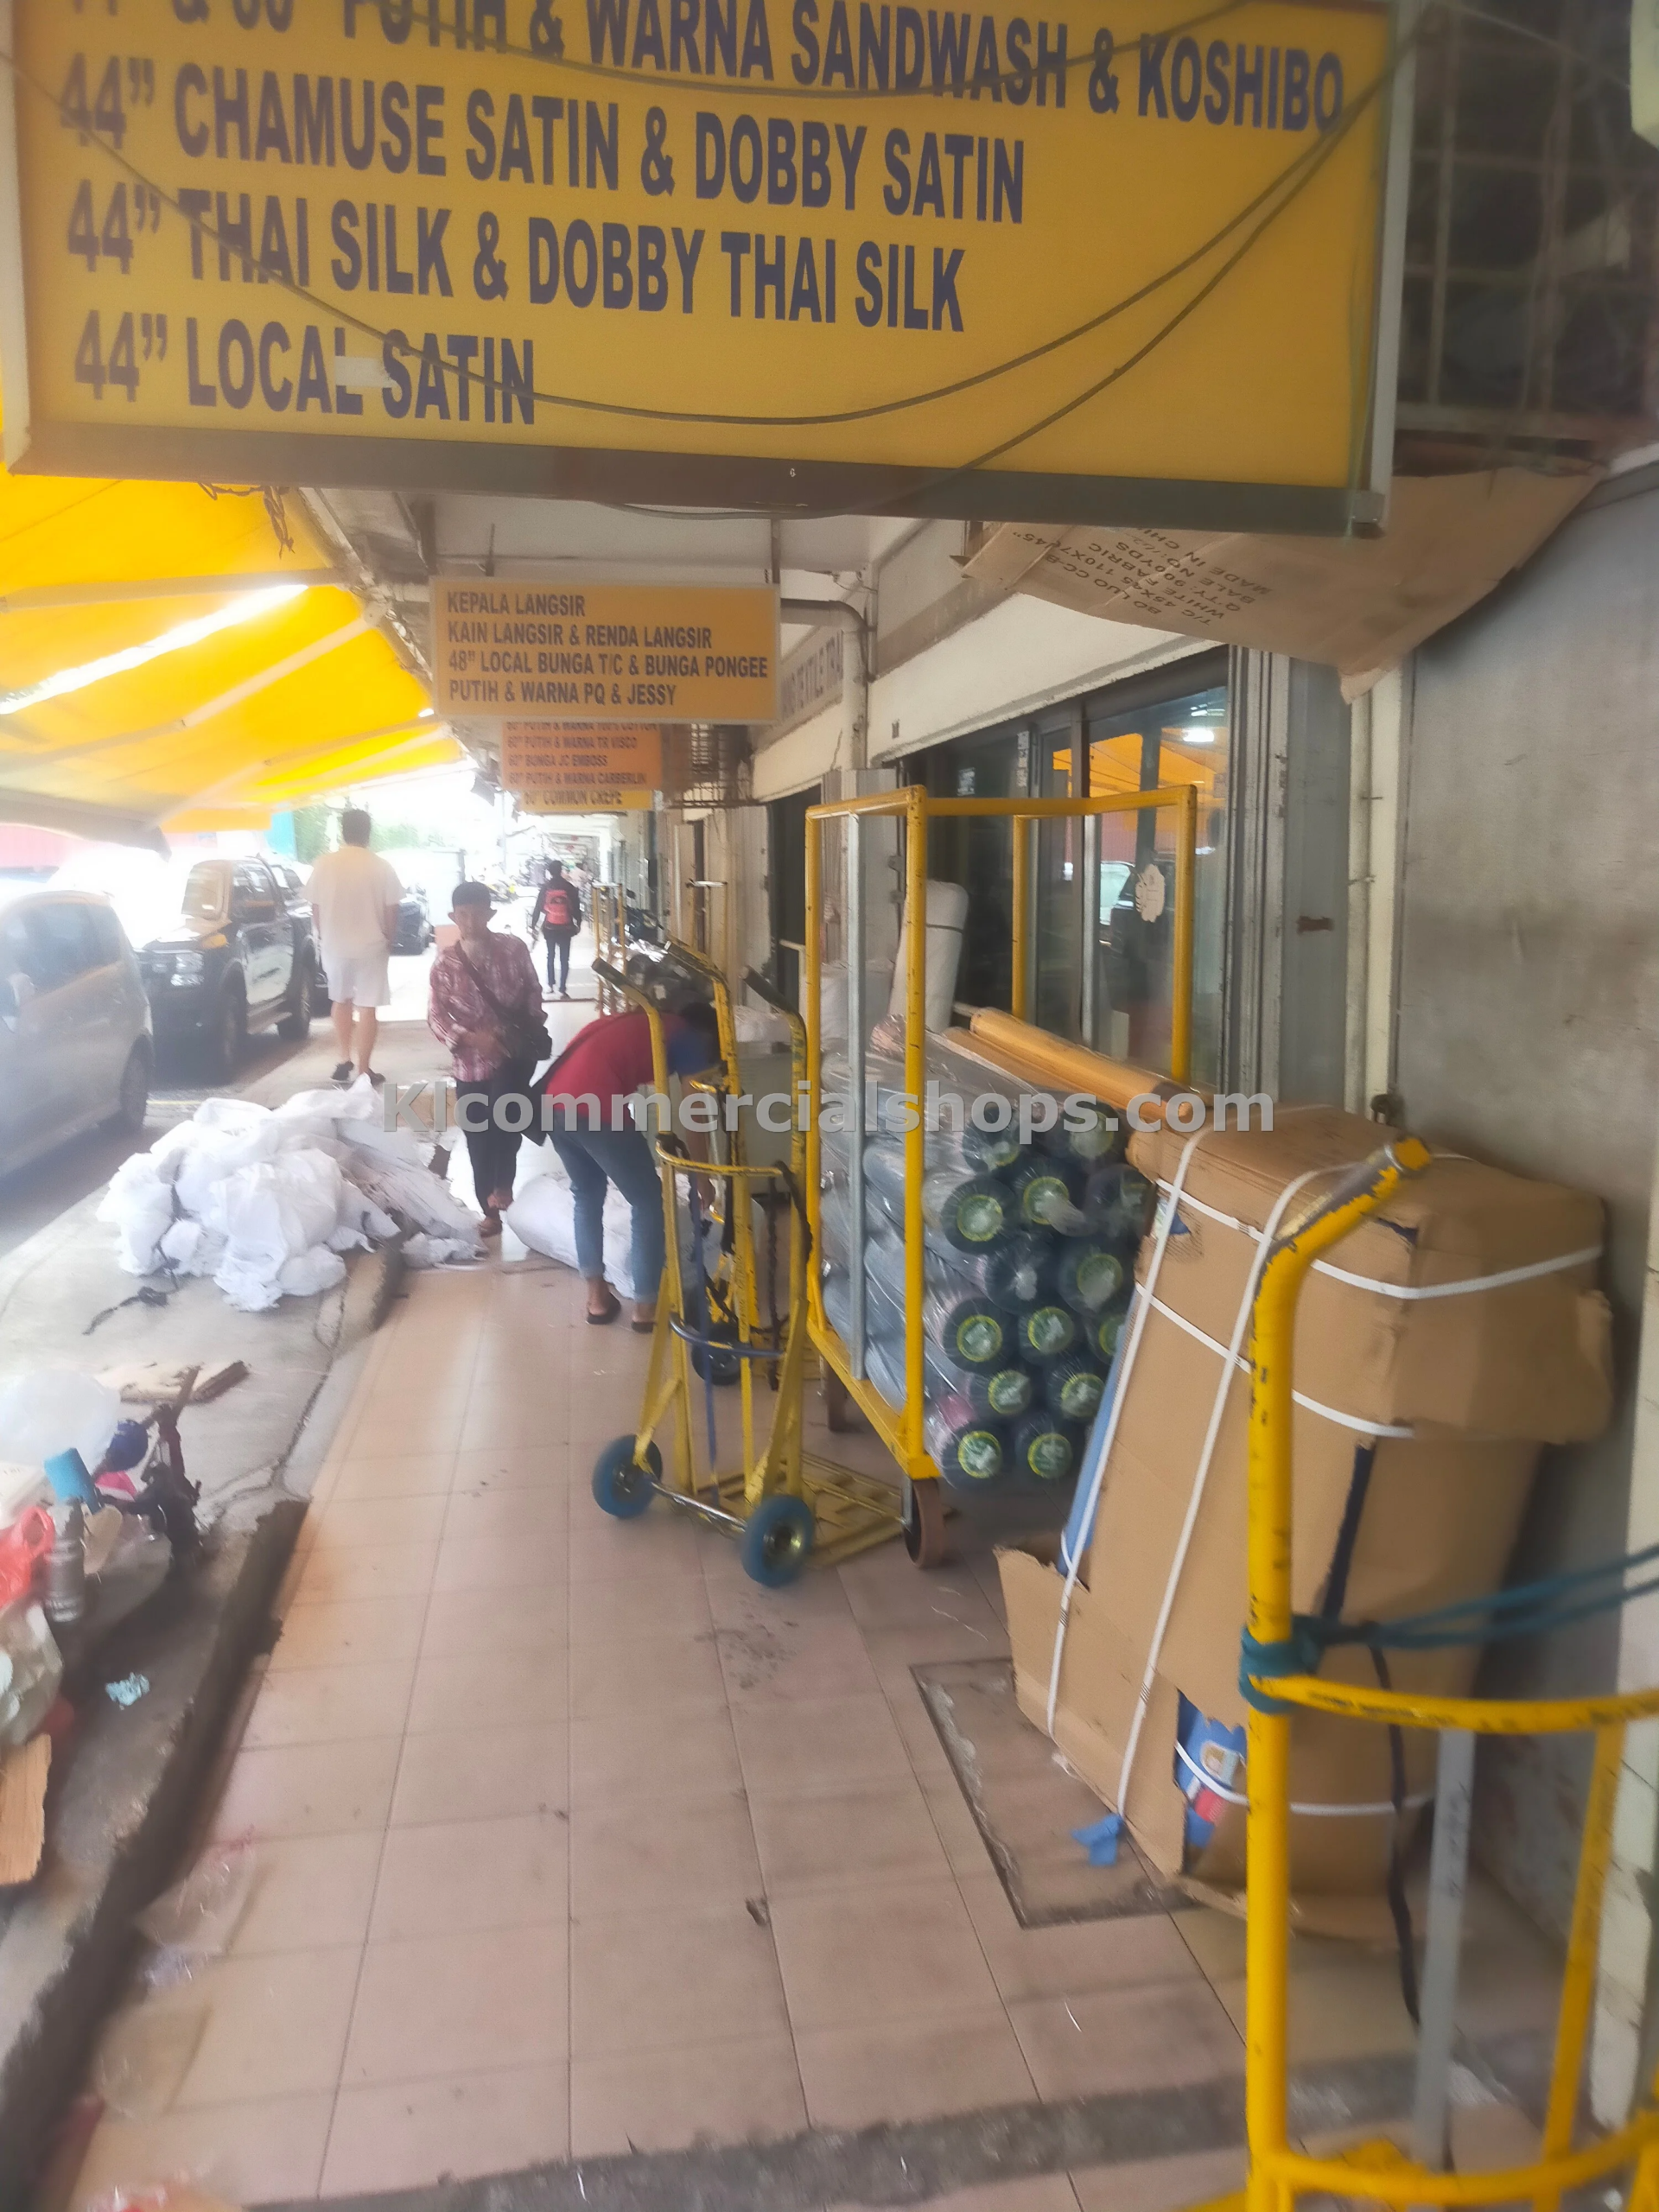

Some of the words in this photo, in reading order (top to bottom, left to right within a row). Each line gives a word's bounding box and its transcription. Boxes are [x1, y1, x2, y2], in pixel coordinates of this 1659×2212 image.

[586, 0, 774, 81] WARNA
[791, 0, 1068, 110] SANDWASH
[1089, 28, 1121, 115] &
[1138, 31, 1344, 132] KOSHIBO
[175, 62, 447, 175] CHAMUSE
[466, 89, 620, 191] SATIN
[642, 107, 675, 196] &
[696, 111, 867, 211] DOBBY
[884, 125, 1025, 224] SATIN
[177, 188, 310, 288] THAI
[331, 200, 454, 298] SILK
[474, 212, 508, 301] &
[530, 217, 705, 315] DOBBY
[721, 231, 836, 324] THAI
[855, 241, 966, 333] SILK
[186, 317, 363, 416] LOCAL
[382, 329, 535, 425] SATIN
[1137, 527, 1179, 549] CHI
[1088, 543, 1159, 586] FABRIC
[1116, 542, 1186, 587] 900YDS
[1185, 551, 1206, 567] IN
[1121, 576, 1176, 607] 45X45
[1198, 577, 1255, 604] BALE
[1210, 567, 1273, 594] MADE
[447, 591, 510, 614] KEPALA
[515, 594, 586, 617] LANGSIR
[1134, 601, 1162, 614] BO
[1163, 587, 1224, 619] WHITE
[1181, 609, 1211, 626] T/C
[448, 620, 488, 644] KAIN
[493, 623, 563, 645] LANGSIR
[569, 624, 580, 645] &
[586, 624, 639, 647] RENDA
[644, 626, 712, 648] LANGSIR
[480, 651, 532, 673] LOCAL
[537, 652, 594, 675] BUNGA
[628, 654, 639, 676] &
[645, 654, 700, 677] BUNGA
[705, 655, 768, 678] PONGEE
[449, 679, 499, 702] PUTIH
[504, 681, 516, 702] &
[520, 681, 580, 704] WARNA
[583, 682, 606, 706] PQ
[611, 683, 622, 705] &
[626, 683, 677, 706] JESSY
